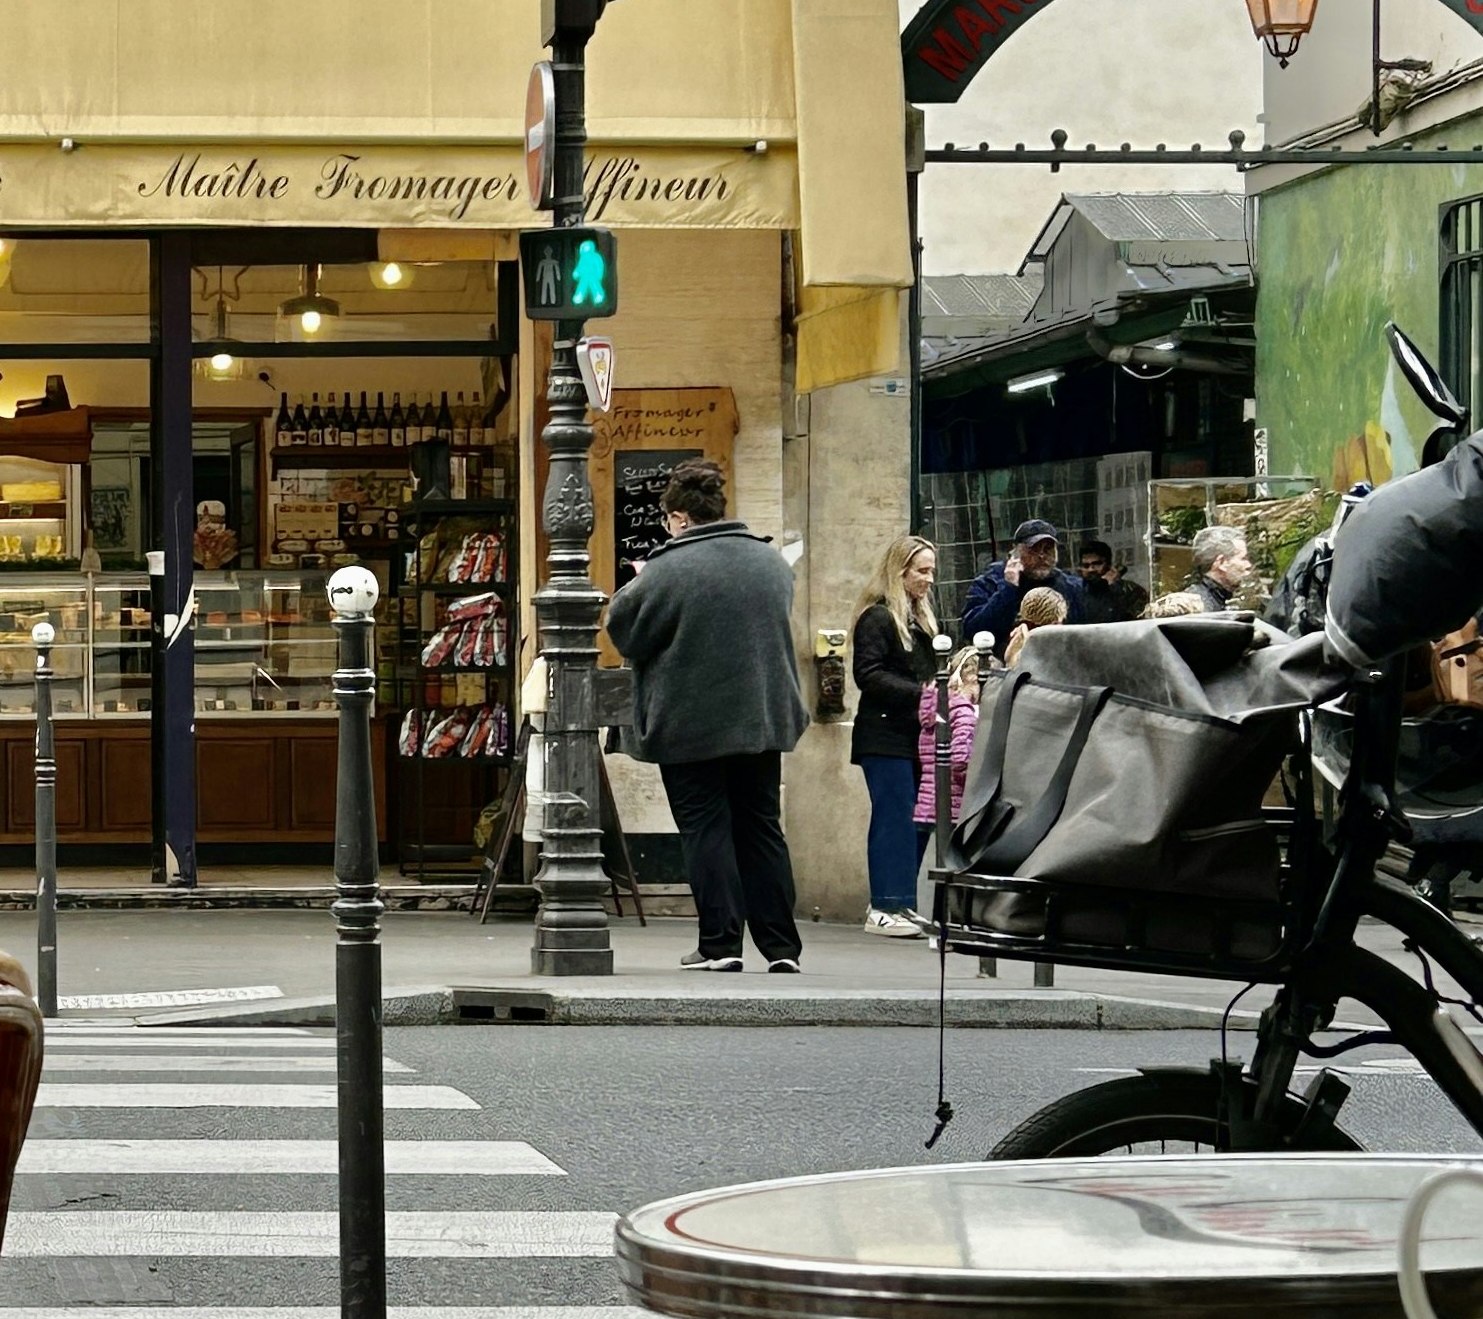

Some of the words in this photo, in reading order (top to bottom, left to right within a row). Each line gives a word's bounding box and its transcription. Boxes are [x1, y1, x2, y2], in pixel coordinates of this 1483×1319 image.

[137, 152, 291, 199] Maître
[314, 153, 522, 220] Fromager
[583, 154, 731, 222] ffineur
